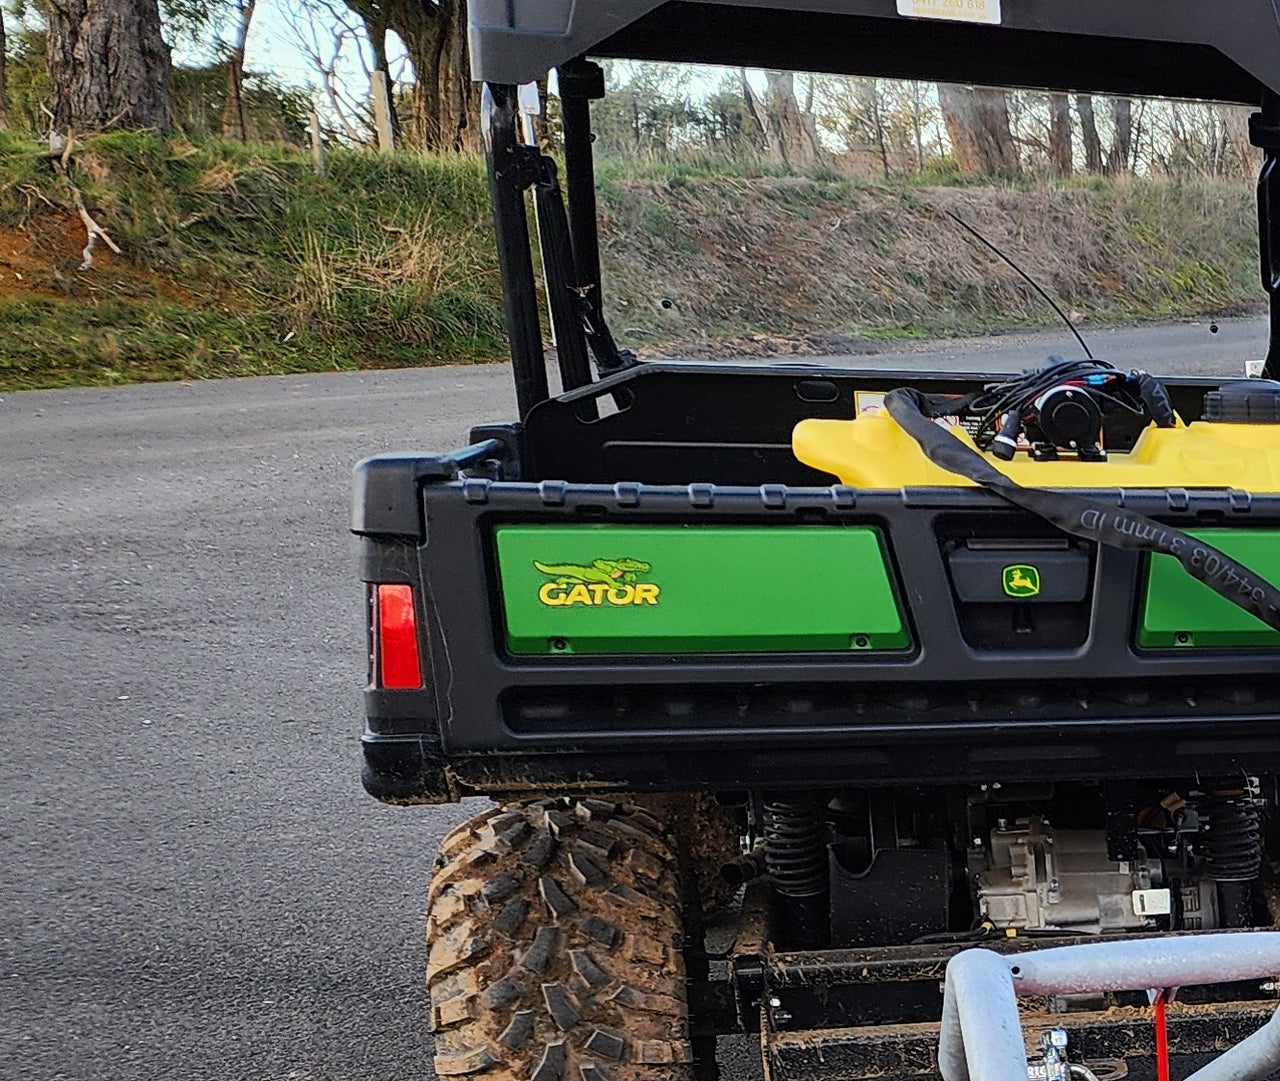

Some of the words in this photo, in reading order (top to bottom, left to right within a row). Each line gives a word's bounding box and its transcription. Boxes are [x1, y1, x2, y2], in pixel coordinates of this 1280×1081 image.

[1080, 509, 1104, 528] ID
[1113, 516, 1186, 555] 31mm
[1191, 547, 1266, 602] 344/03
[538, 582, 660, 606] GATOR
